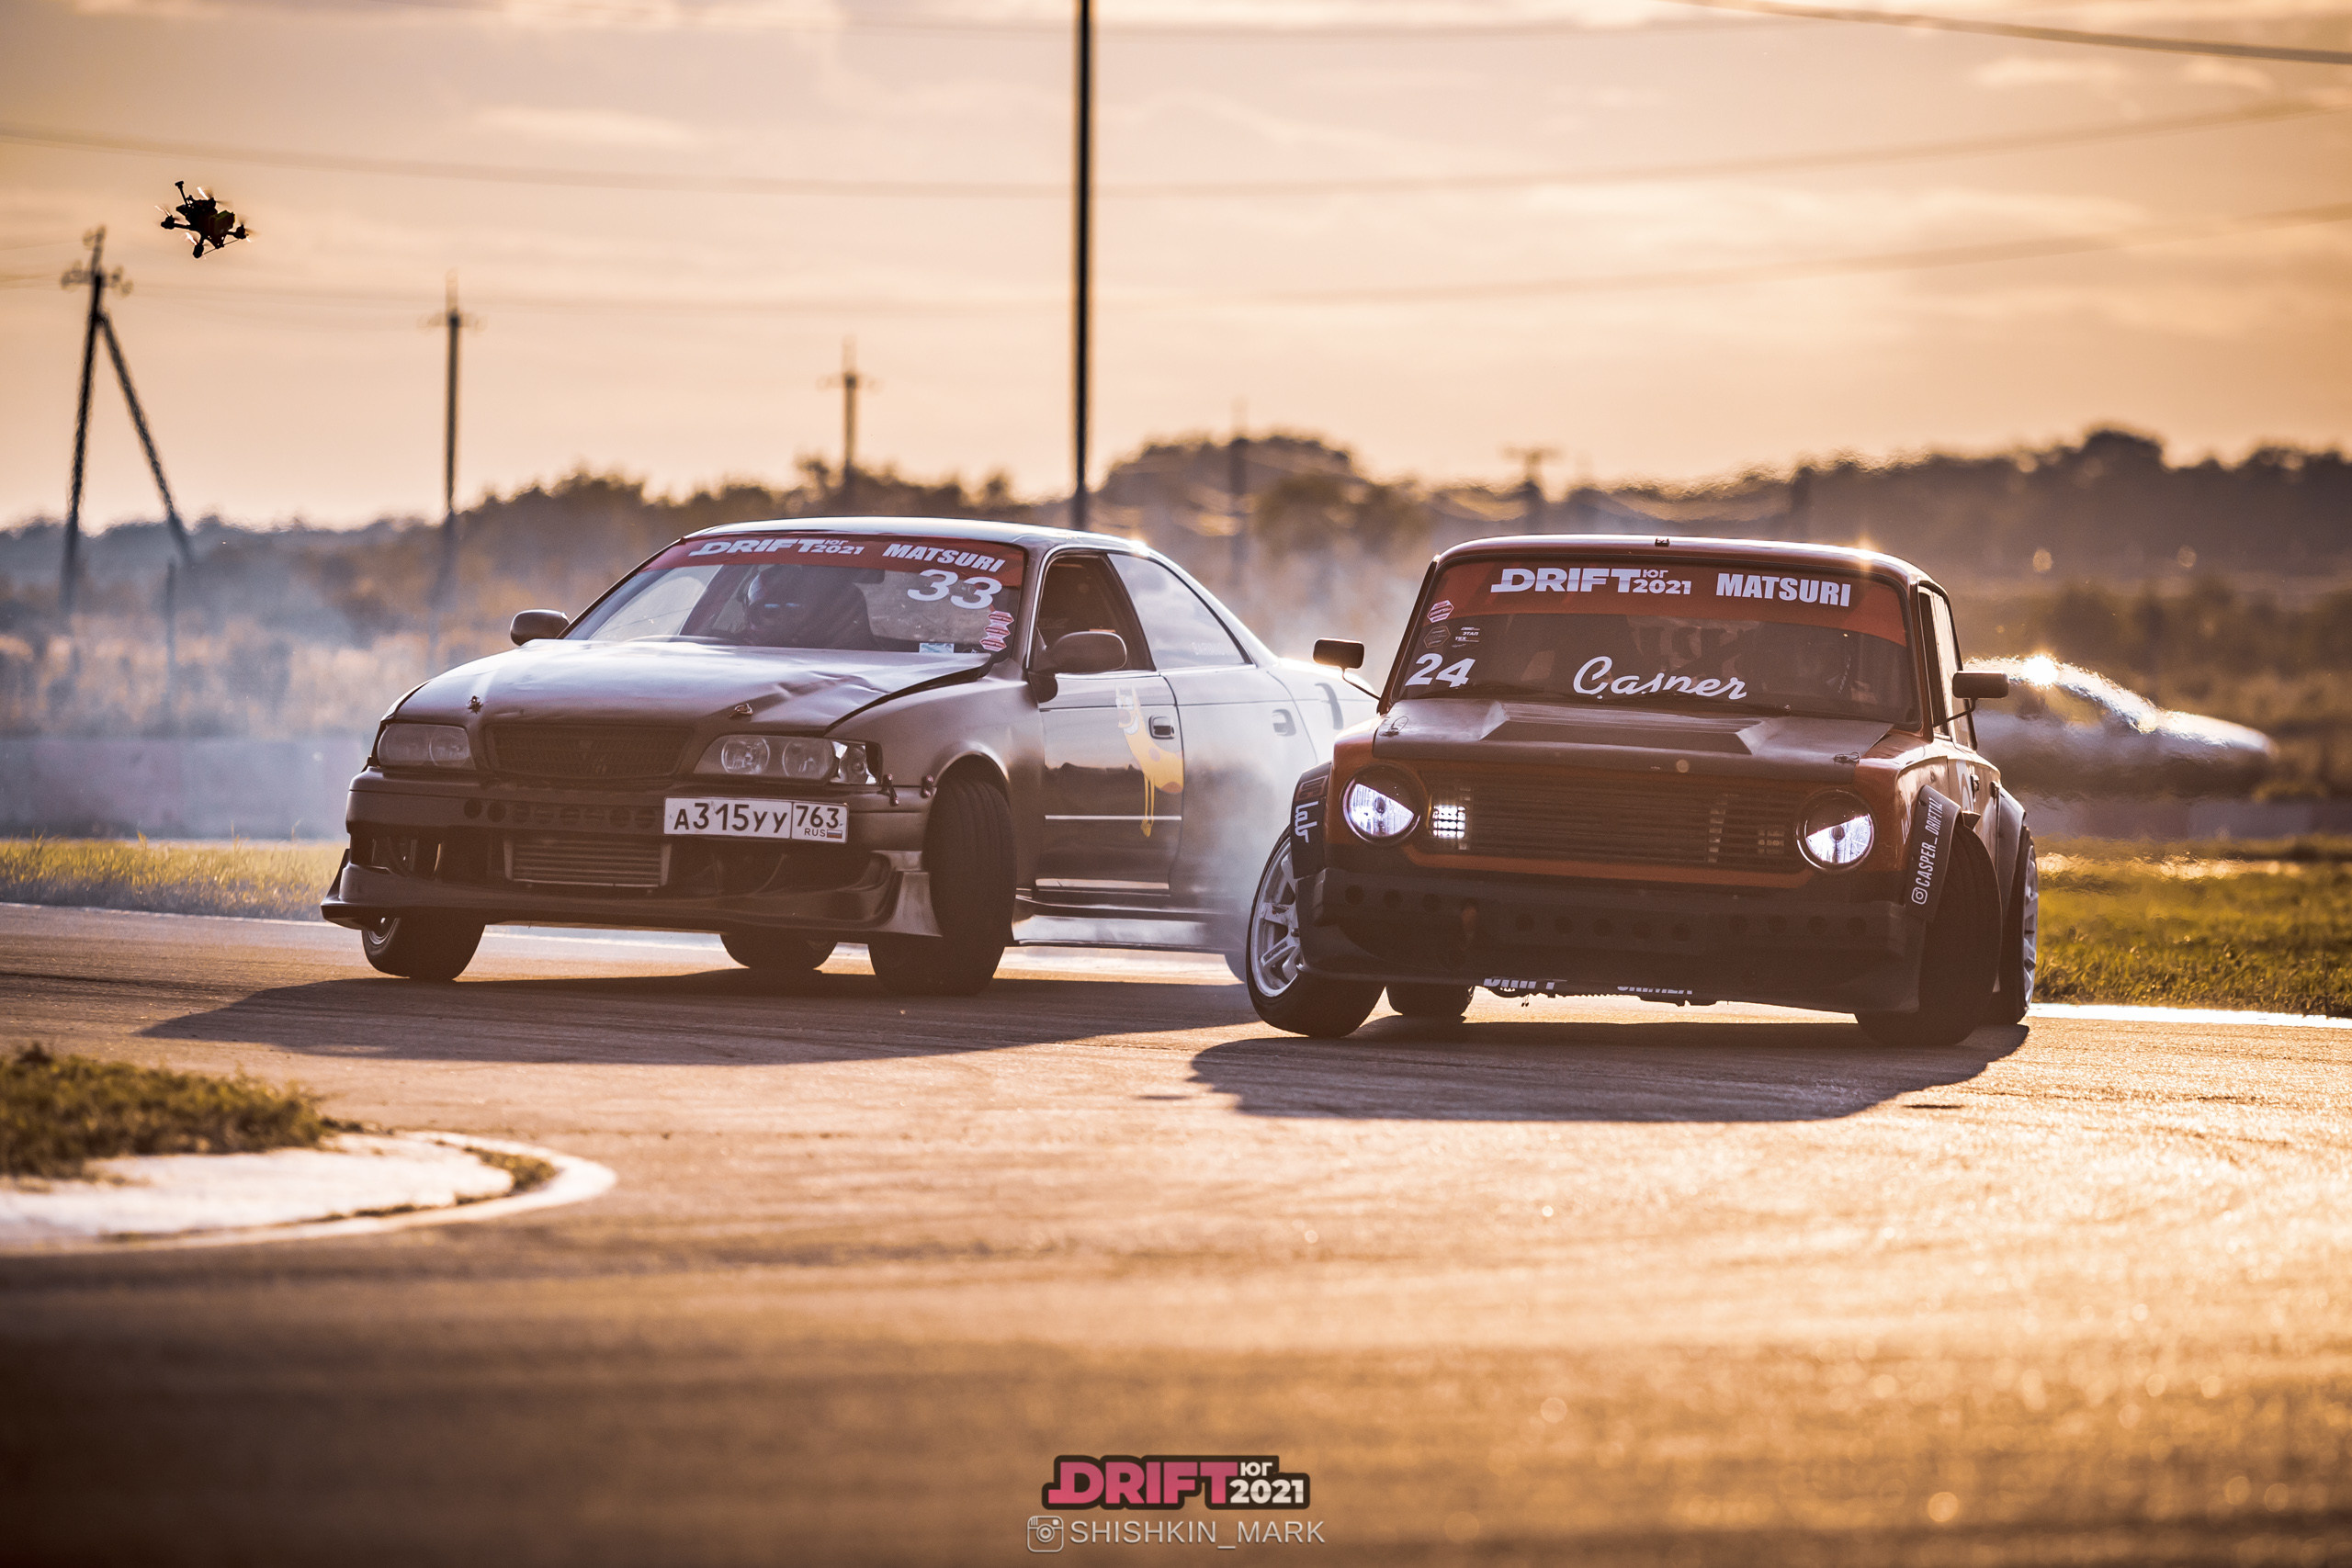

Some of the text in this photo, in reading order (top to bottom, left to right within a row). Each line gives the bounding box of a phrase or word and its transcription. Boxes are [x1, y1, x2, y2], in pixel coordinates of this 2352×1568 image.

[689, 538, 1006, 573] DRIFT MATSURI
[810, 545, 865, 555] 2021
[1643, 569, 1668, 578] ЮГ
[907, 569, 1002, 610] 33
[1490, 568, 1851, 607] DRIFT MATSURI
[1632, 579, 1692, 595] 2021
[1404, 652, 1476, 688] 24
[796, 805, 840, 829] 763
[804, 828, 826, 838] RUS
